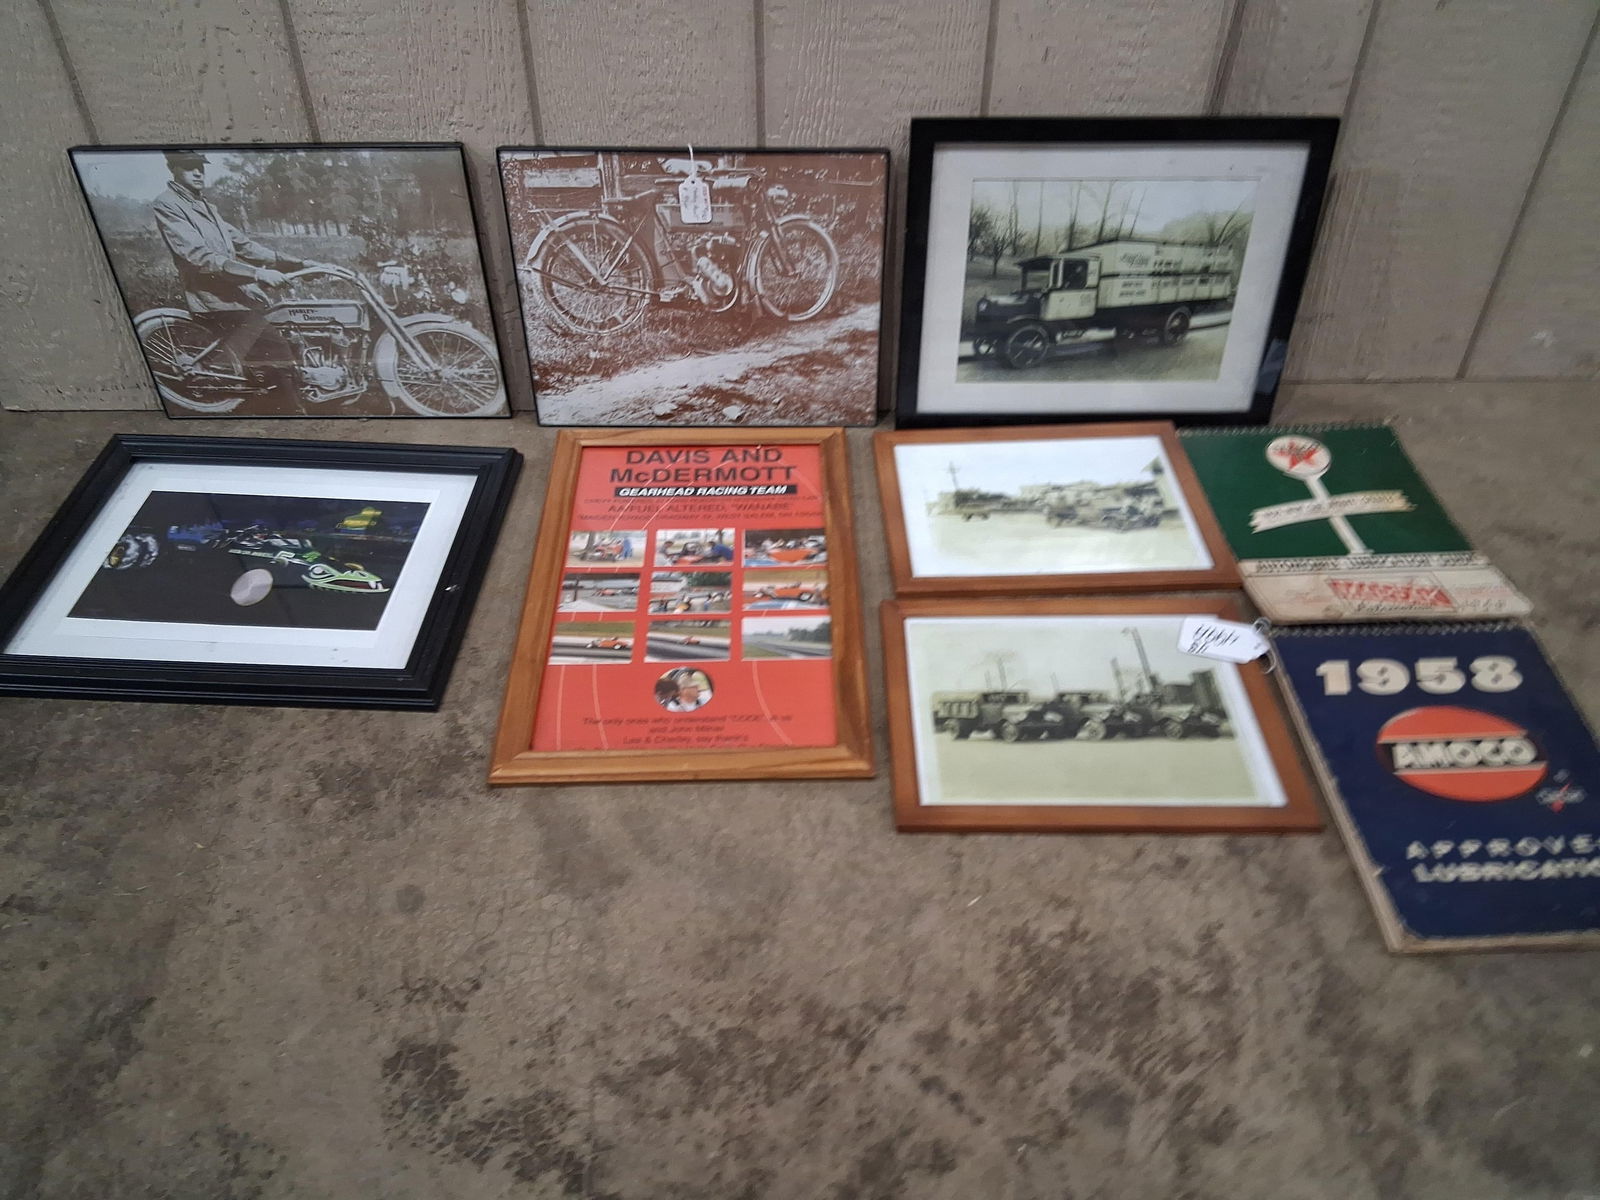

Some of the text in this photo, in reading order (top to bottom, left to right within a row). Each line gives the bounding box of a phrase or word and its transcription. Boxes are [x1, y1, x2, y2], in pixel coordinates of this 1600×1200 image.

[626, 447, 784, 465] DAVIS AND
[609, 465, 797, 483] McDERMOTT
[618, 484, 788, 498] GEARHEAD RACING TEAM
[1314, 654, 1524, 696] 1958
[1406, 834, 1600, 860] APPROVE
